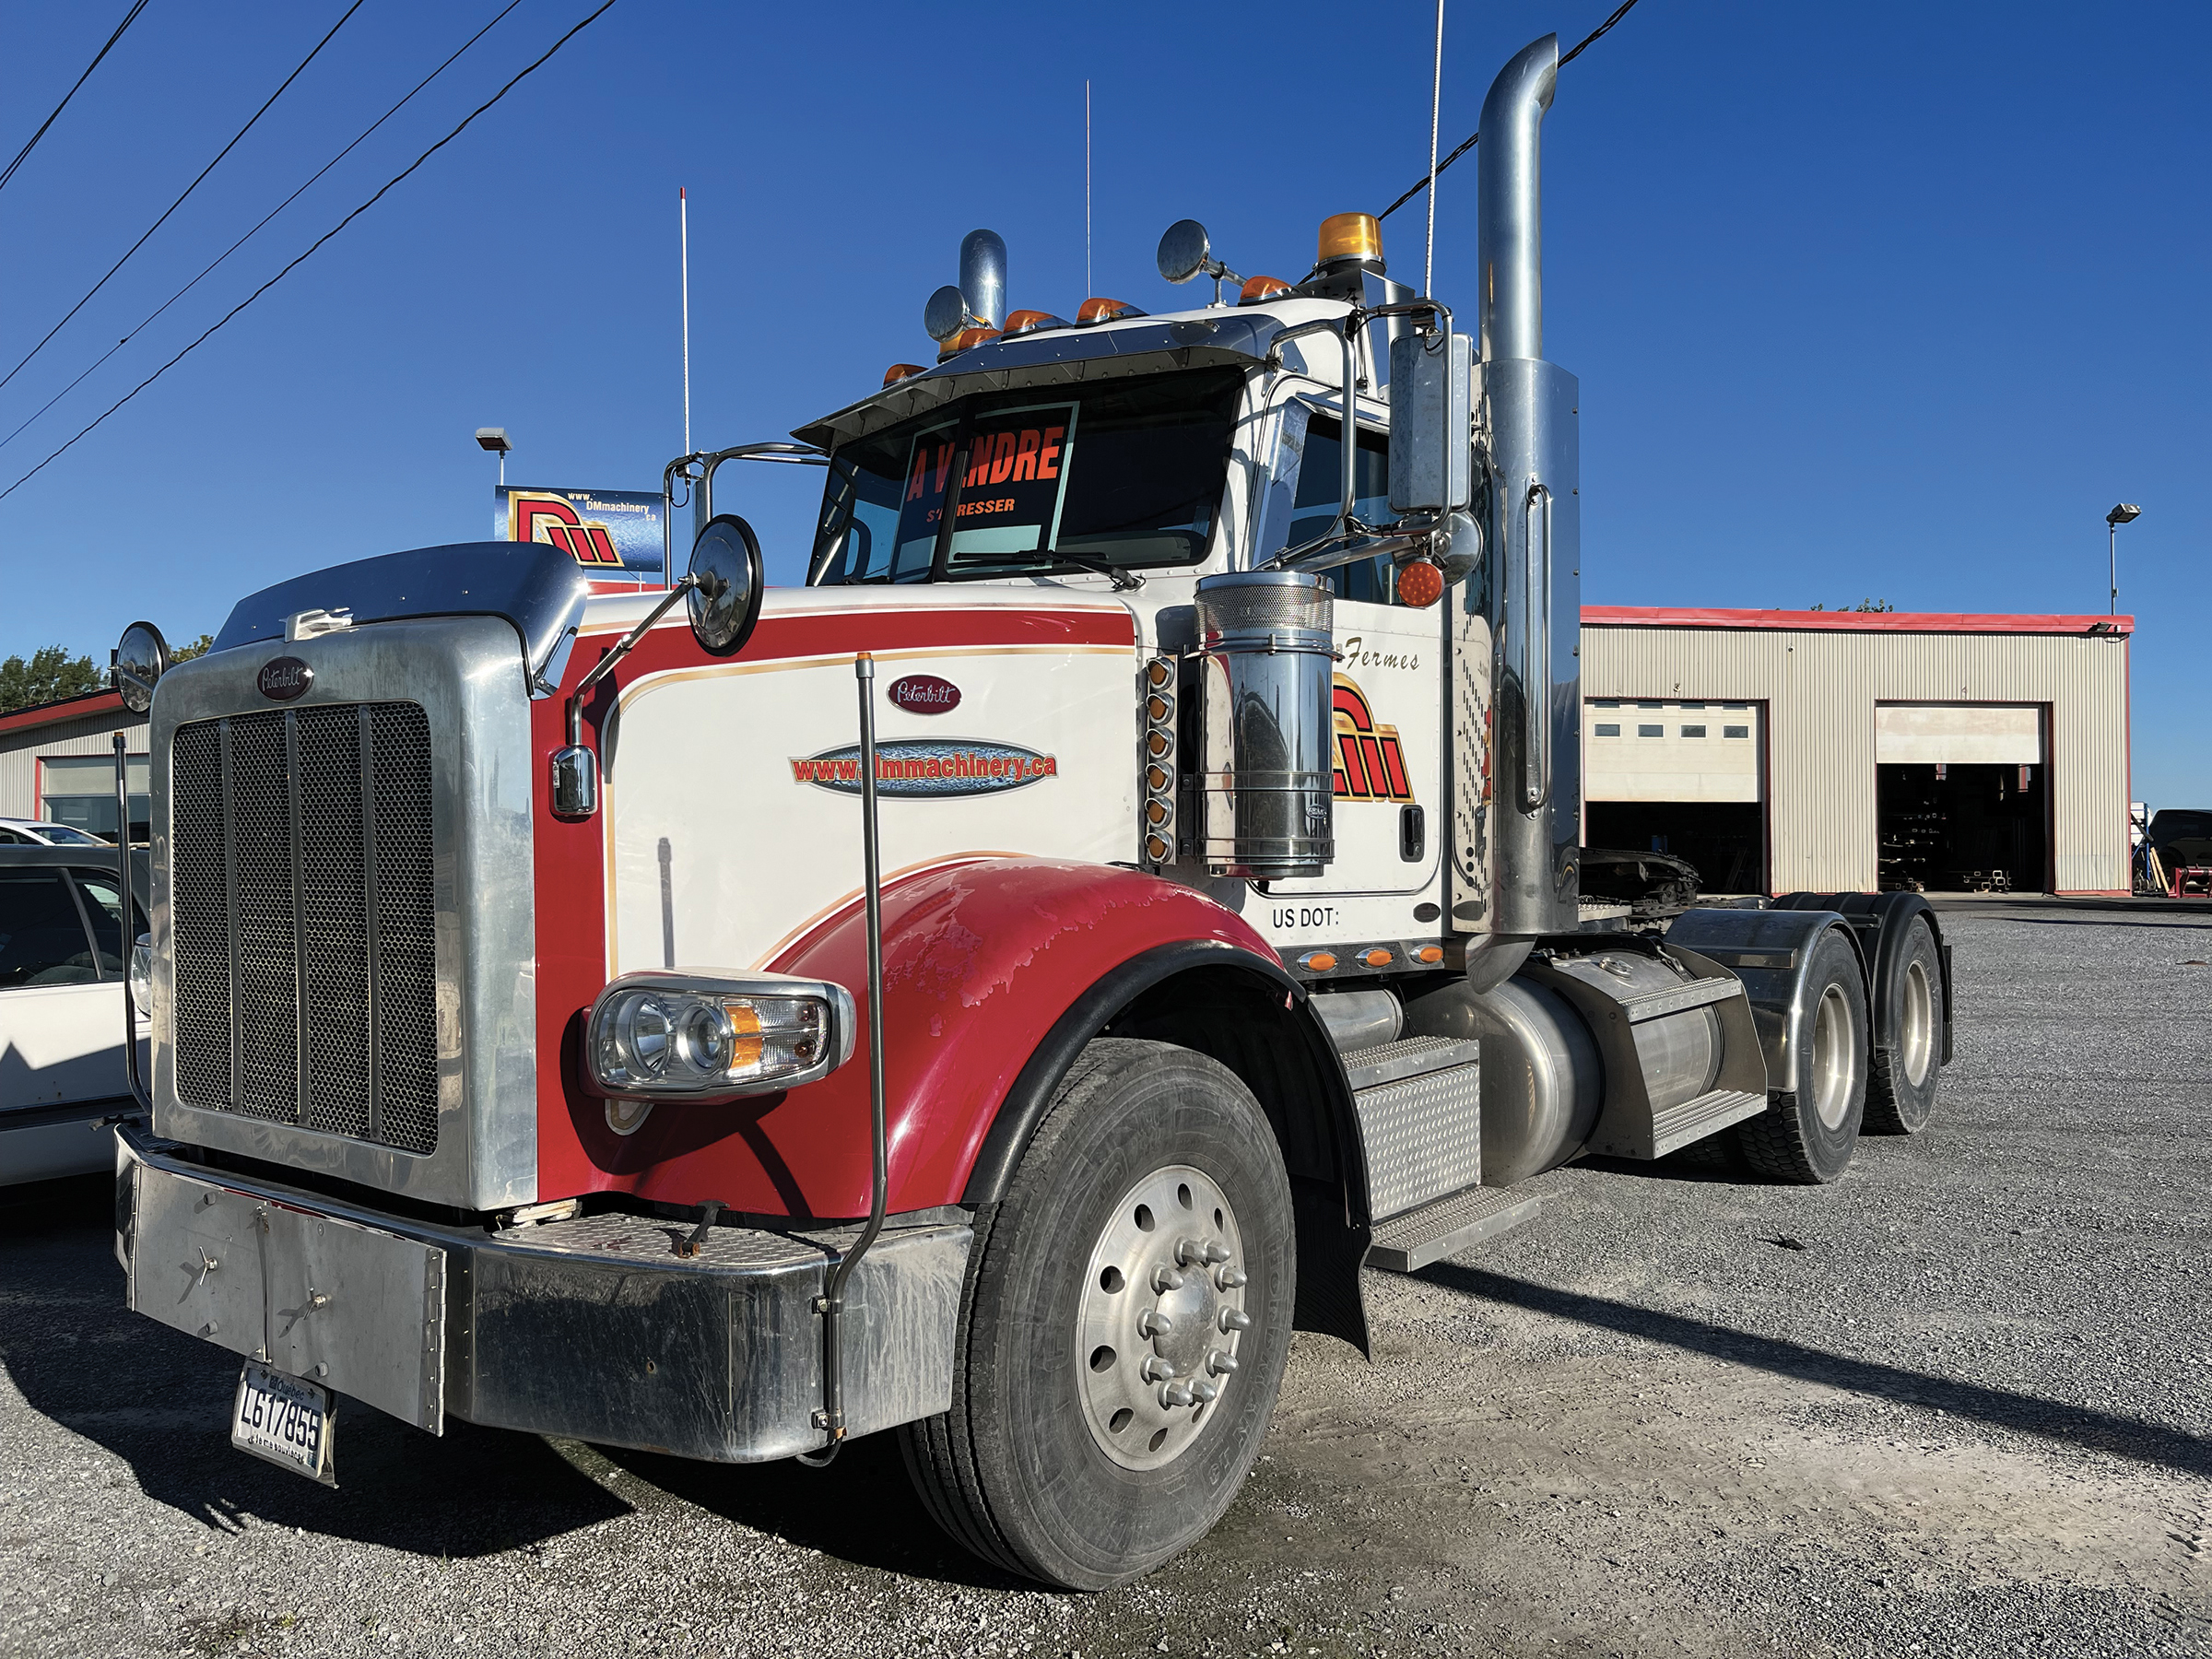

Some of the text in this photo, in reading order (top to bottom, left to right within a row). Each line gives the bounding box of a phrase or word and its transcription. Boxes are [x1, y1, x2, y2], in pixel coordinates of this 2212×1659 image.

[907, 427, 1065, 501] A VNDRE
[586, 500, 649, 514] DMmachinery
[926, 499, 1015, 523] S'RESSER
[1346, 636, 1419, 671] Fermes
[262, 666, 303, 692] Peterbilt
[897, 680, 956, 703] Peterbilt
[1273, 907, 1339, 928] US DOT:
[276, 1379, 305, 1401] Québec
[241, 1383, 321, 1452] L617855
